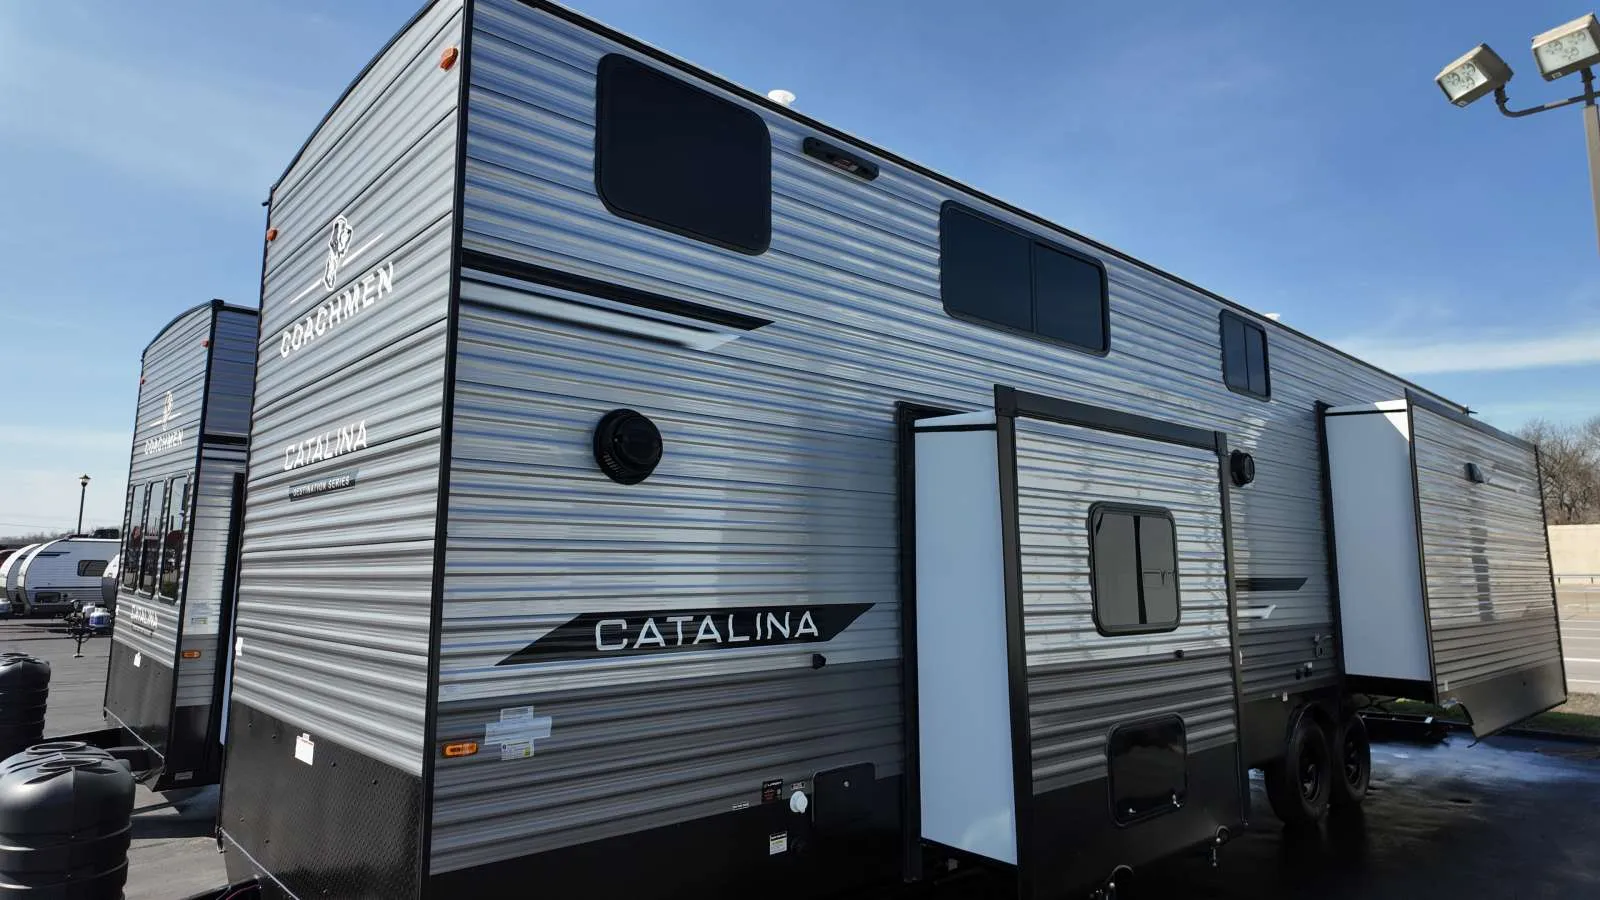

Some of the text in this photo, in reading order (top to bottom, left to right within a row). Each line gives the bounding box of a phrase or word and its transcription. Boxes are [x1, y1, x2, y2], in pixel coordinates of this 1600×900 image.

[281, 261, 394, 358] COACHMEN
[145, 429, 184, 455] COACHMEN
[284, 419, 367, 470] CATALINA
[293, 475, 350, 497] DESTINATION SERIES
[595, 610, 819, 650] CATALINA
